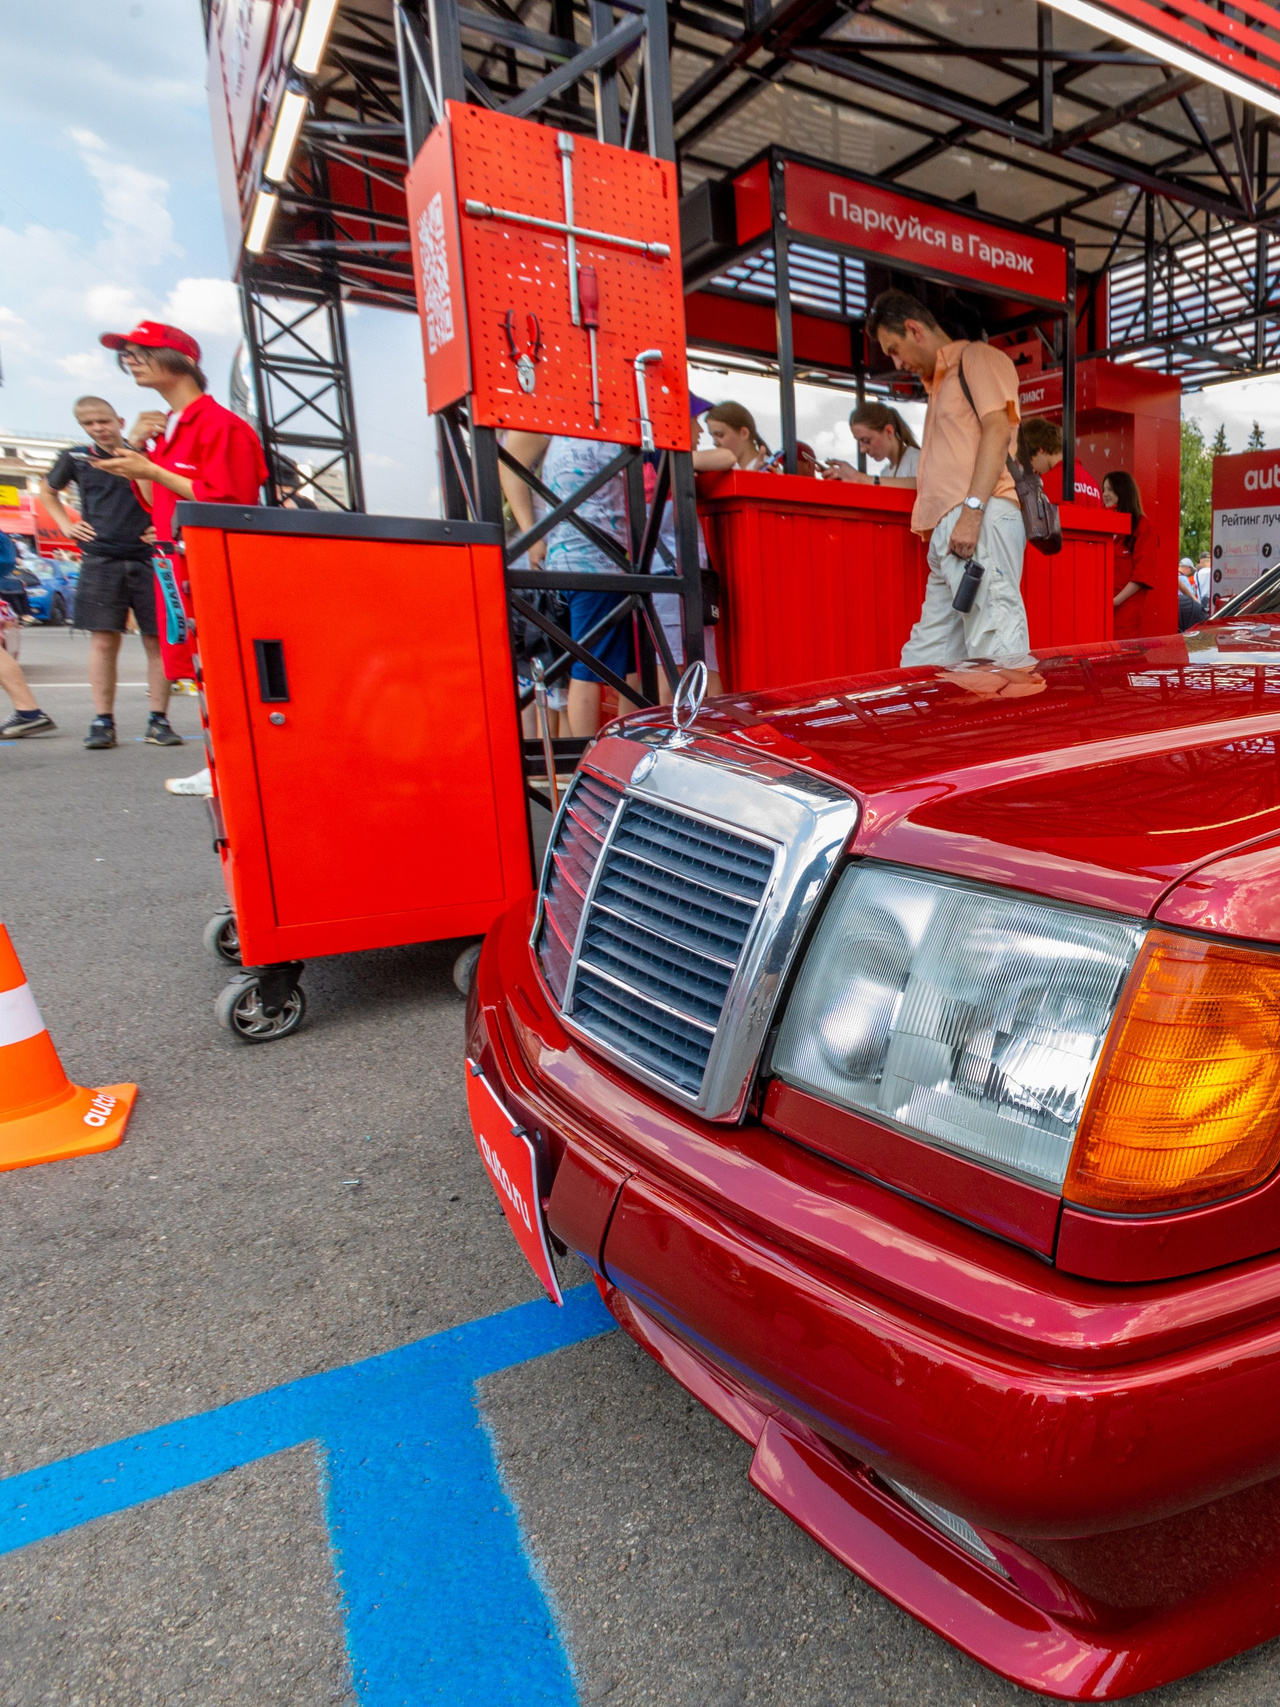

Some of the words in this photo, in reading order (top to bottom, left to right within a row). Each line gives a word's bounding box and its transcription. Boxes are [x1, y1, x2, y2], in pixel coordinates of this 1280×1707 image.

[829, 191, 946, 248] Паркуйся
[951, 234, 964, 253] в
[968, 234, 1034, 275] Гараж
[1221, 513, 1262, 527] Рейтинг
[479, 1133, 533, 1234] auto.ru
